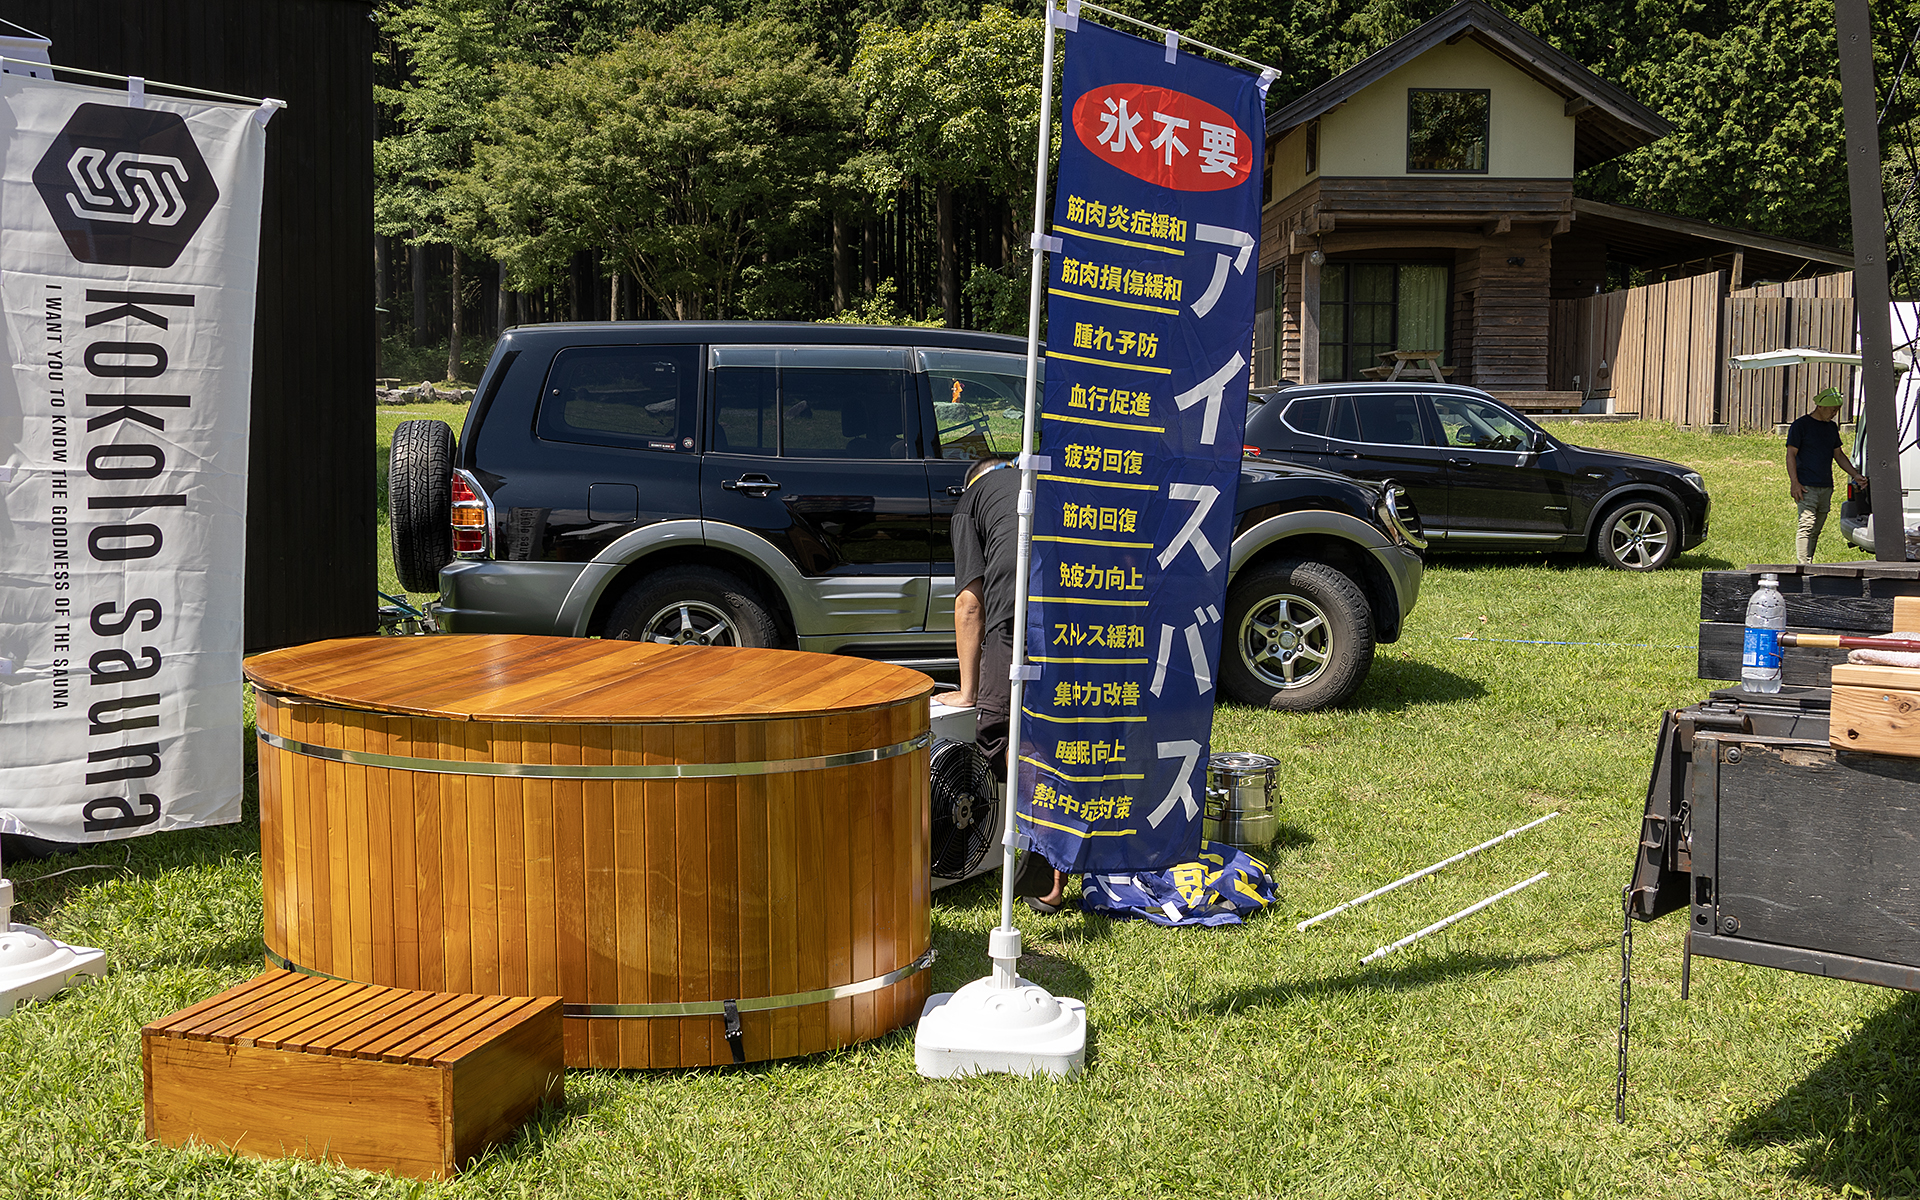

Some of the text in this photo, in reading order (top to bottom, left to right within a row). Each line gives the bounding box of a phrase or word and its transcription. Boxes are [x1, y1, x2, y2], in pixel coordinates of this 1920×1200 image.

[1096, 97, 1238, 178] 氷不要
[1066, 194, 1188, 243] 筋肉炎症緩和
[1060, 256, 1183, 302] 筋肉損傷緩和
[45, 297, 63, 344] WANT
[1073, 321, 1159, 359] 腫れ予防
[47, 350, 64, 381] YOU
[49, 388, 66, 408] TO
[1068, 382, 1152, 418] 血行促進
[51, 414, 67, 463] KNOW
[1064, 442, 1144, 476] 疲労回復
[52, 469, 68, 499] THE
[1062, 501, 1138, 533] 筋肉回復
[1146, 222, 1256, 829] アイスバス
[51, 506, 70, 591] GOODNESS
[81, 289, 196, 833] kokolo sauna
[1059, 561, 1144, 591] 免疫力向上
[54, 597, 70, 617] OF
[53, 622, 70, 653] THE
[1052, 622, 1145, 649] ストレス緩和
[52, 658, 69, 710] SAUNA
[1053, 681, 1141, 707] 集中力改善
[1055, 739, 1127, 766] 睡眠向上
[1032, 782, 1134, 823] 熱中症対策
